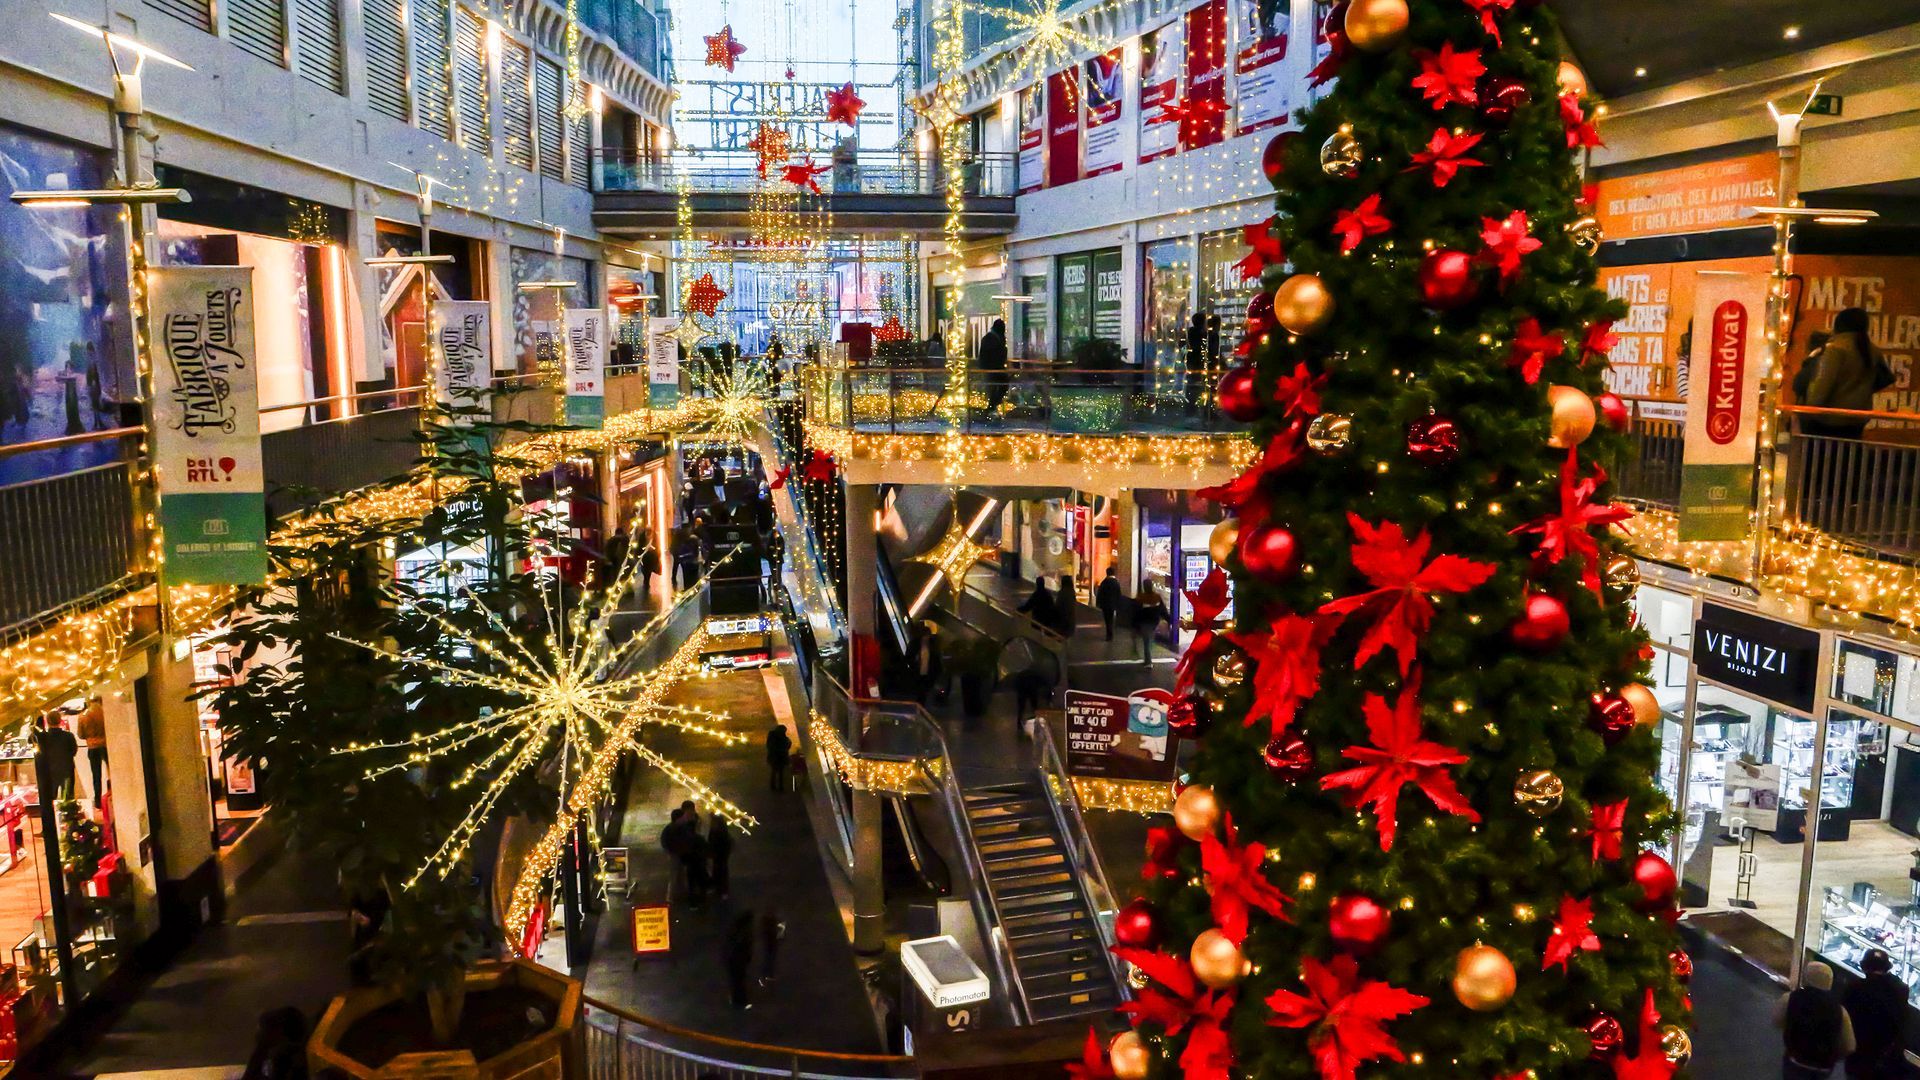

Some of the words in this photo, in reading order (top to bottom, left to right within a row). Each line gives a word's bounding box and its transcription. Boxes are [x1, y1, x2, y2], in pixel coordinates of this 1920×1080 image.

[1607, 274, 1650, 304] METS
[1807, 276, 1885, 312] METS
[204, 290, 245, 369] JOUETS
[1609, 336, 1640, 363] ANS
[1645, 336, 1663, 364] TA
[1717, 310, 1740, 409] Kruidvat
[171, 313, 228, 437] FABRIQUE
[187, 457, 213, 468] bel
[187, 469, 219, 482] RTL
[1706, 629, 1787, 674] VENIZI
[1727, 661, 1757, 677] BIJOUX
[1073, 716, 1085, 726] DE
[1087, 717, 1099, 726] 40
[1096, 708, 1114, 717] CARD
[1072, 741, 1104, 751] OFFERTE
[940, 991, 987, 1005] Photomaton
